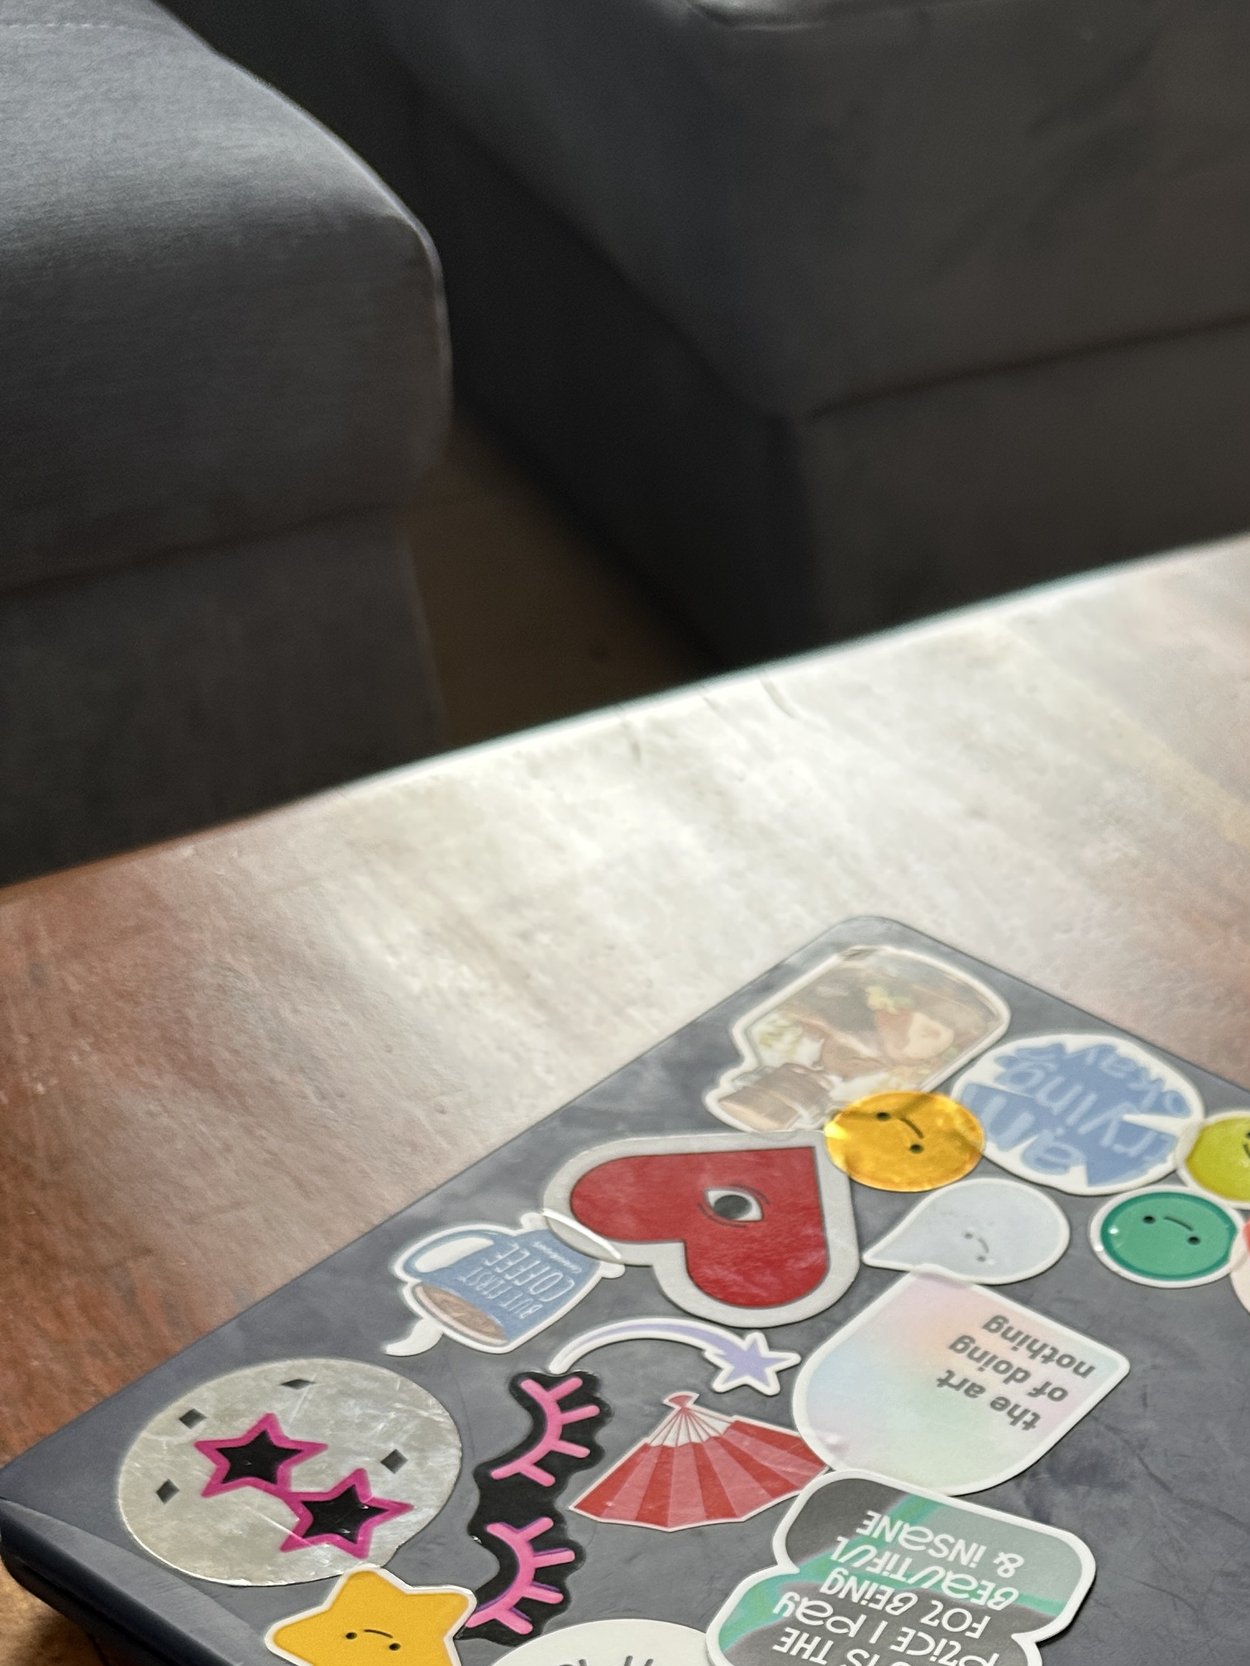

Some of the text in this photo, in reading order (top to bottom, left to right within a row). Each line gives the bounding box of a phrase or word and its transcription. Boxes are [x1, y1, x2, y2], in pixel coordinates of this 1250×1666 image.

[457, 1267, 543, 1319] BUT FIRST
[483, 1242, 575, 1302] COFFEE
[948, 1334, 1069, 1402] of doing
[982, 1314, 1096, 1379] nothing
[935, 1369, 1042, 1432] the art
[993, 1551, 1025, 1578] &
[772, 1627, 834, 1665] THE
[869, 1620, 888, 1644] I
